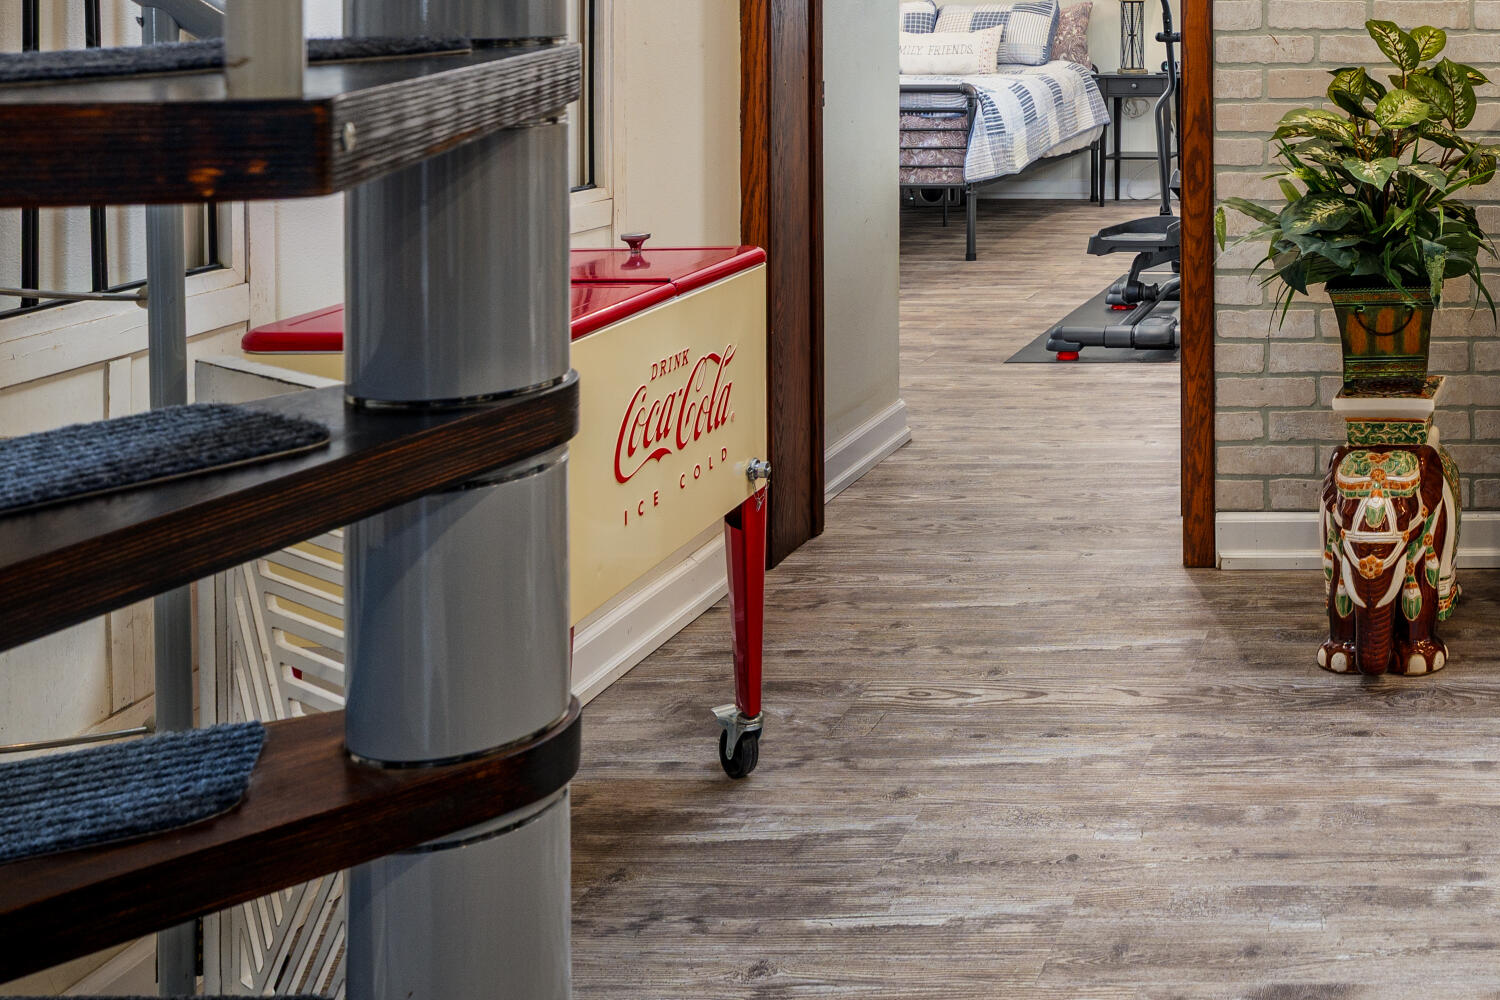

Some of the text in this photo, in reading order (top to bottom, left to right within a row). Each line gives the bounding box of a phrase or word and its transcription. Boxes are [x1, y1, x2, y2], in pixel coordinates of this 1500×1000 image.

[928, 43, 974, 56] FRIENDS
[650, 347, 689, 381] DRINK
[624, 447, 728, 526] ICE COLD
